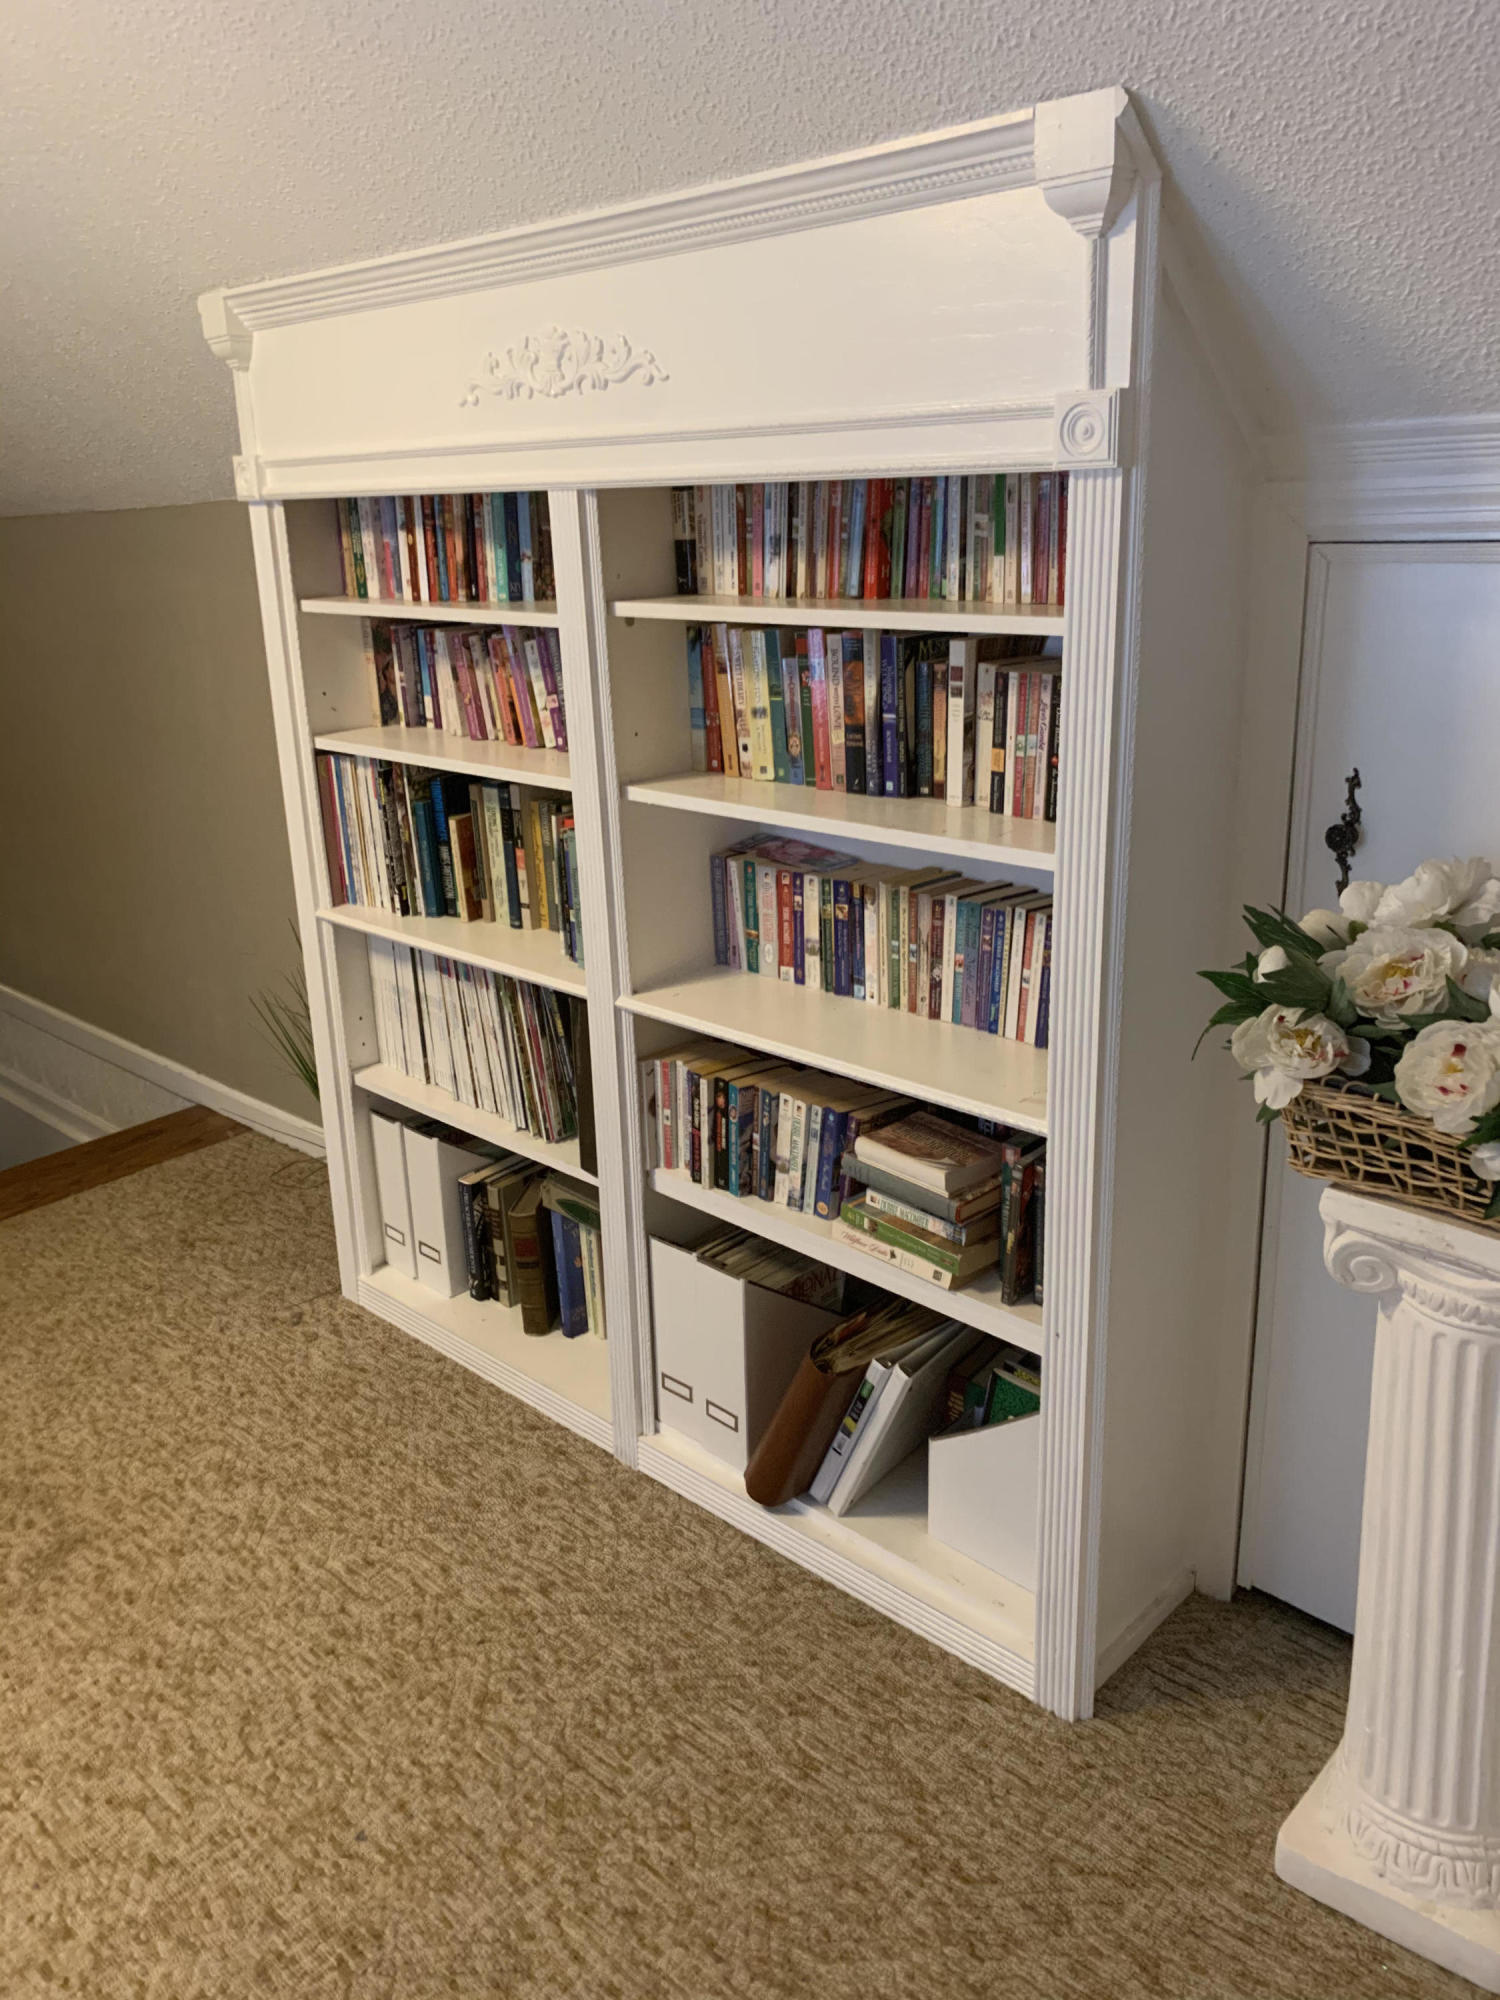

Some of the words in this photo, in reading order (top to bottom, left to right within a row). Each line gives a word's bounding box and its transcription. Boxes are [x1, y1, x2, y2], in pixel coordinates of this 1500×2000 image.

[830, 648, 840, 686] BOUND
[833, 705, 842, 731] LOVE
[441, 846, 452, 865] JAMES
[443, 865, 456, 899] PATTERSON
[879, 1198, 898, 1216] DEBBIE
[900, 1206, 930, 1231] MACOMBER
